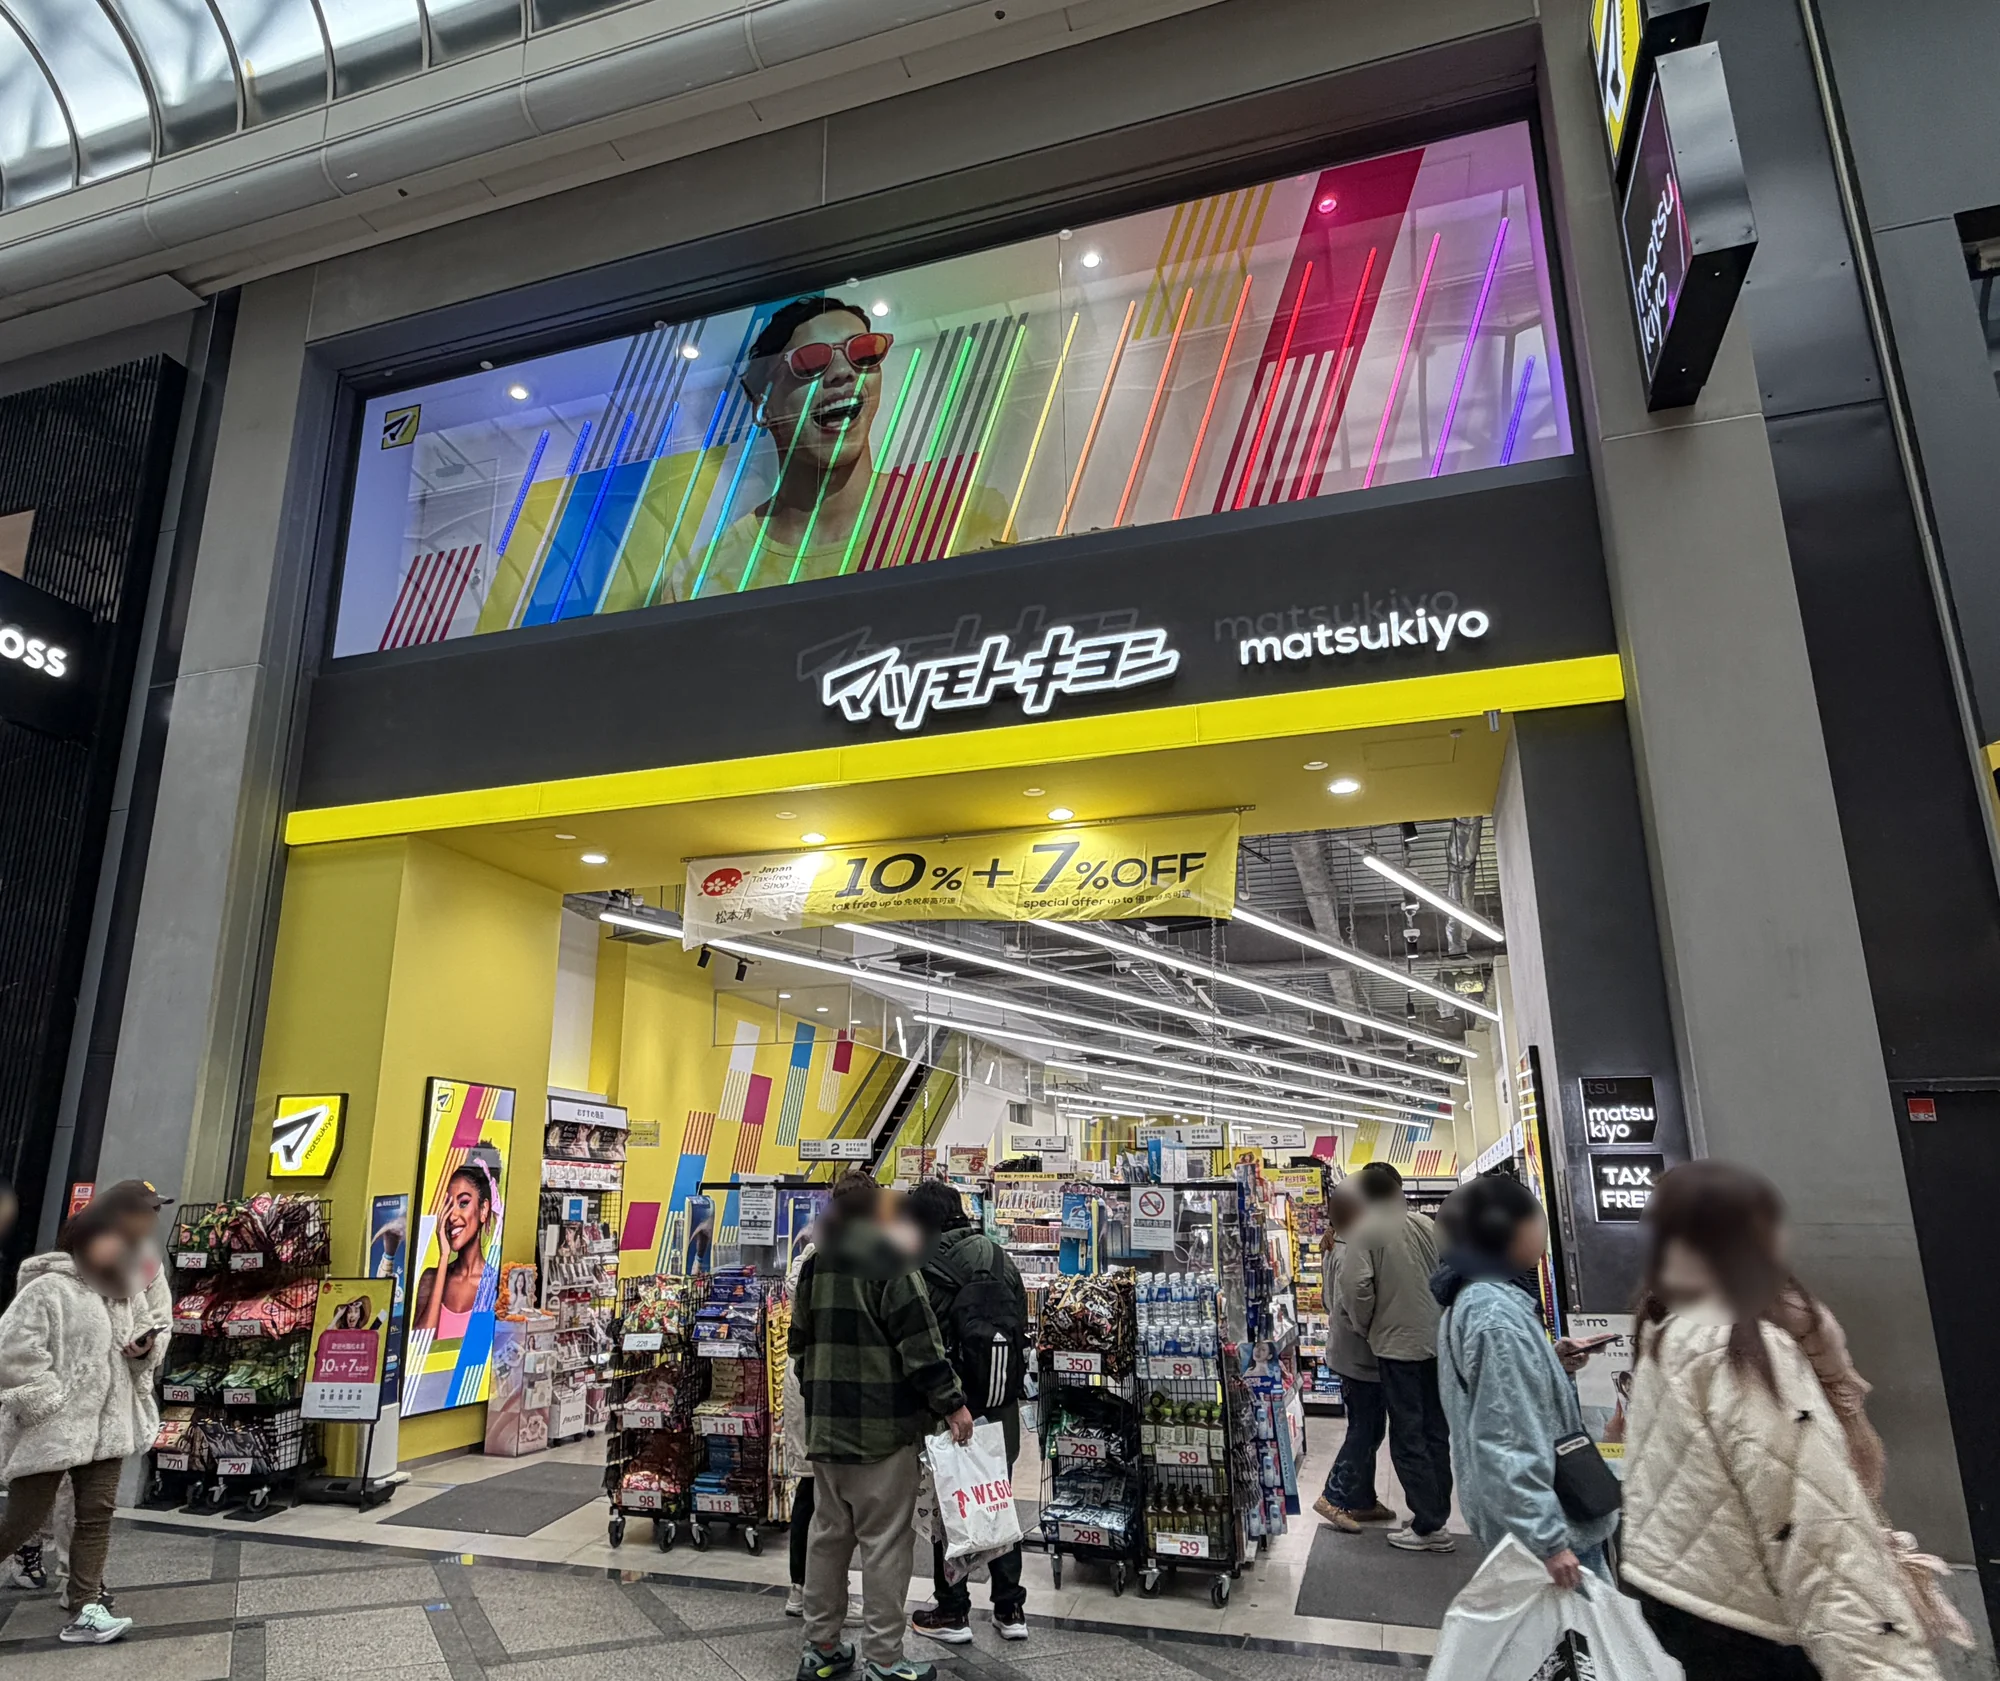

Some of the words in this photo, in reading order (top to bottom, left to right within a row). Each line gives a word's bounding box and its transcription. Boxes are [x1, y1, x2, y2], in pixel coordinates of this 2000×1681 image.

[1637, 172, 1675, 311] matsu
[1641, 271, 1668, 354] kiyo
[1240, 607, 1490, 667] matsukiyo
[758, 865, 793, 874] Japan
[751, 874, 793, 884] Tax-free
[762, 881, 790, 890] Shop
[831, 902, 851, 912] tax
[852, 899, 877, 910] free
[879, 901, 892, 909] up
[1023, 896, 1069, 909] special
[1071, 896, 1104, 907] offer
[1107, 898, 1121, 906] up
[1123, 896, 1133, 904] to
[715, 907, 754, 925] 松本清
[1588, 1105, 1654, 1122] matsu
[305, 1114, 335, 1160] matsukiyo
[1176, 1130, 1183, 1143] 1
[1590, 1122, 1630, 1144] kiyo
[1035, 1138, 1042, 1147] 4
[1270, 1135, 1278, 1145] 3
[831, 1143, 840, 1155] 2
[1602, 1167, 1654, 1186] TAX
[1066, 1357, 1093, 1371] 350
[1172, 1363, 1193, 1376] 89
[640, 1416, 656, 1427] 98
[713, 1422, 736, 1434] 118
[1071, 1443, 1098, 1457] 298
[1178, 1451, 1199, 1464] 89
[228, 1463, 246, 1473] 790
[639, 1495, 655, 1507] 98
[709, 1500, 732, 1512] 118
[1073, 1529, 1101, 1544] 298
[1179, 1541, 1200, 1556] 89
